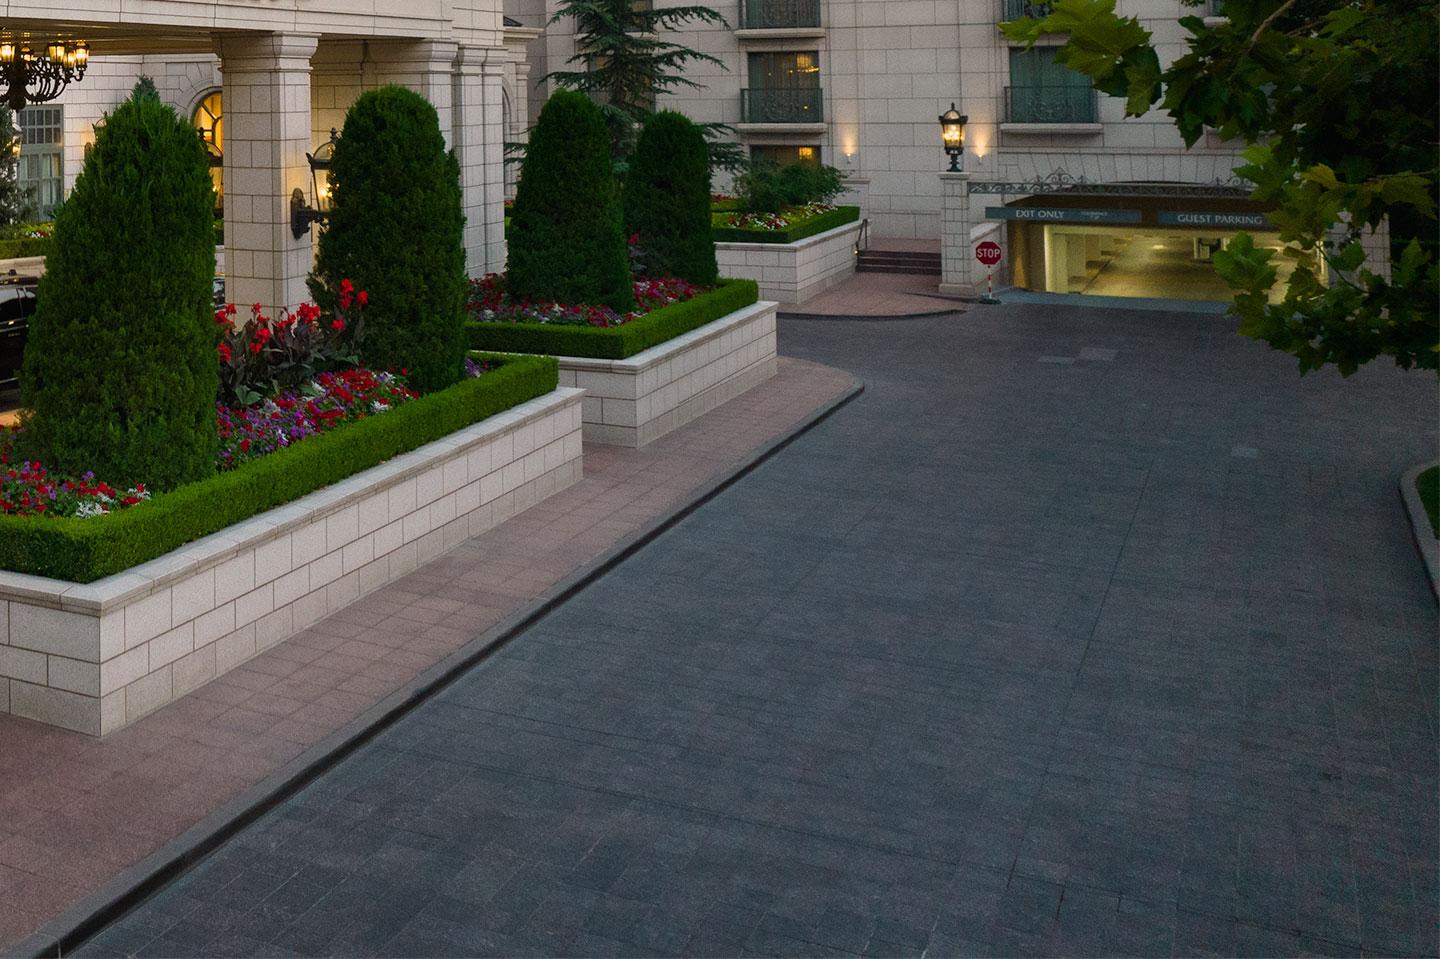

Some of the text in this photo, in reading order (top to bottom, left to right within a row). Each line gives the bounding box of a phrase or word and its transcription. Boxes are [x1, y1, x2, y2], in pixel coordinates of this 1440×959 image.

[1015, 209, 1064, 219] EXIT ONLY
[1177, 214, 1263, 225] GUEST PARKING
[976, 248, 1001, 258] STOP
